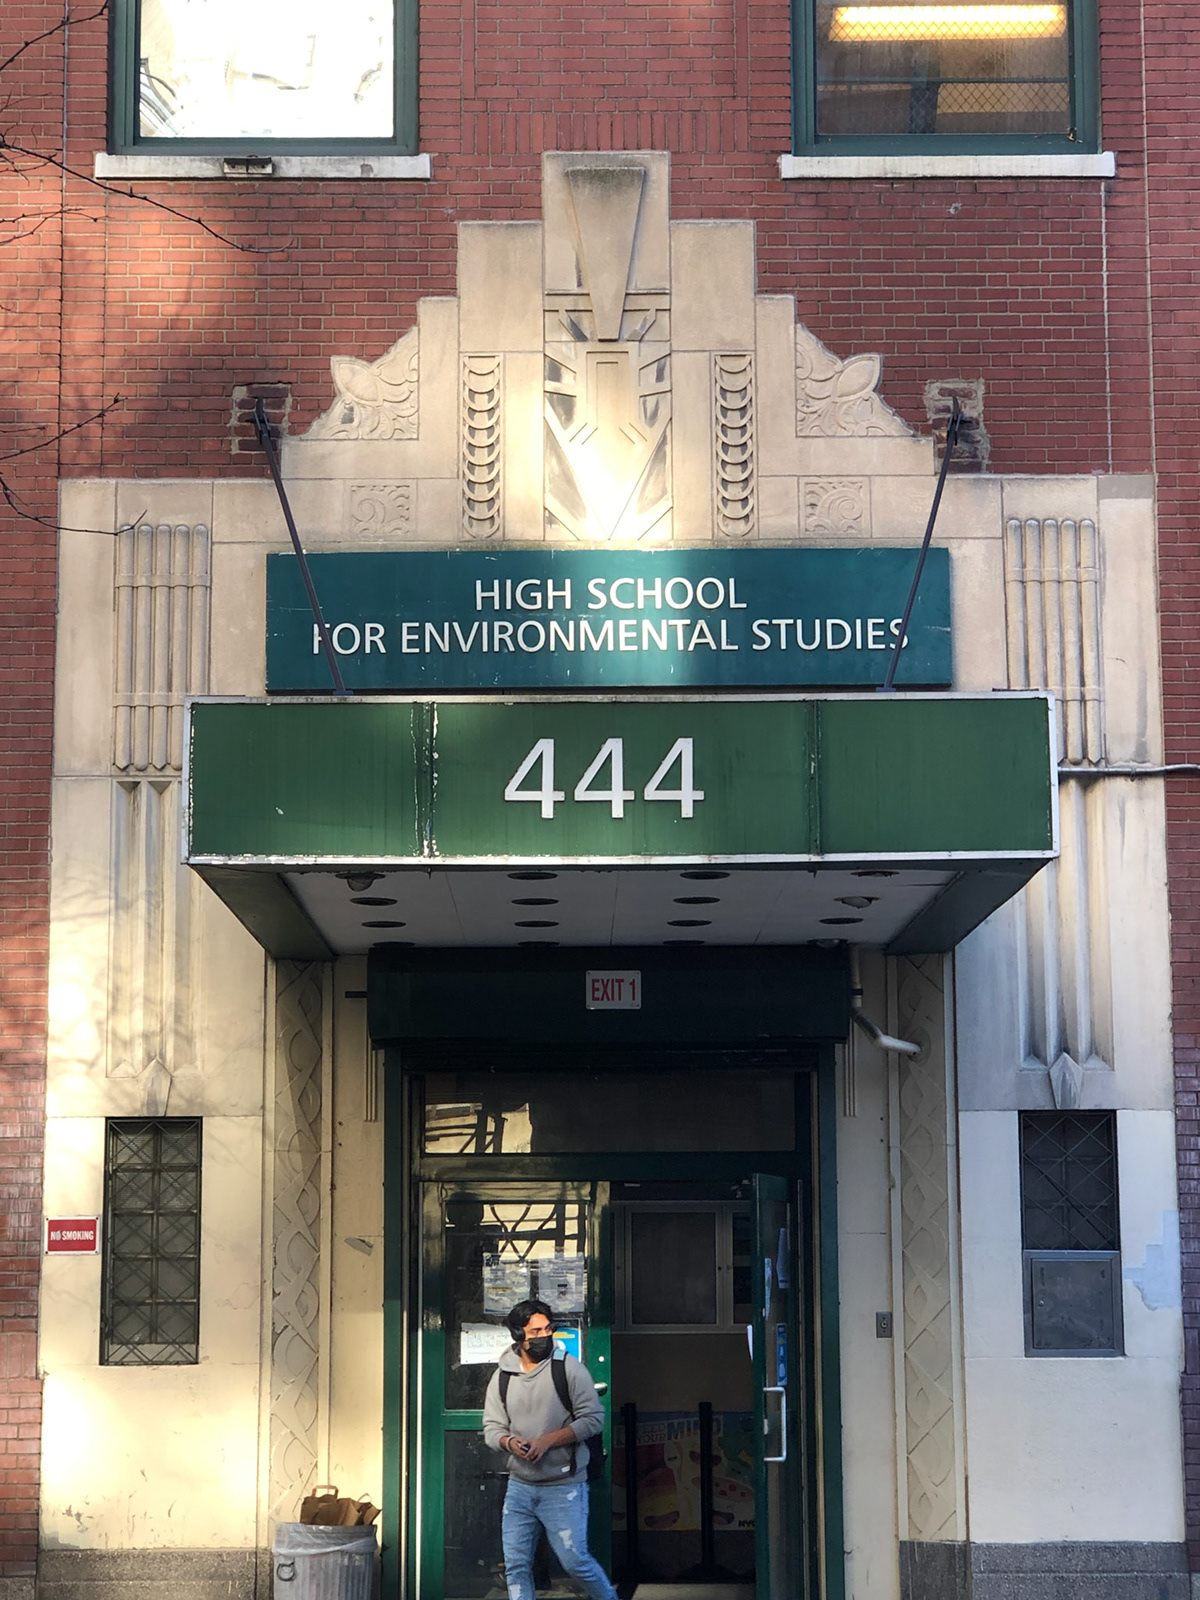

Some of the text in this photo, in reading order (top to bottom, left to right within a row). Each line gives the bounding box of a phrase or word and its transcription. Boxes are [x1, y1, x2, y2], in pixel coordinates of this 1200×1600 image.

[475, 577, 748, 611] HIGH SCHOOL
[313, 618, 909, 655] FOR ENVIRONMENTAL STUDIES
[504, 737, 705, 819] 444
[592, 979, 636, 1001] EXIT 1
[50, 1230, 94, 1241] NO SMOKING
